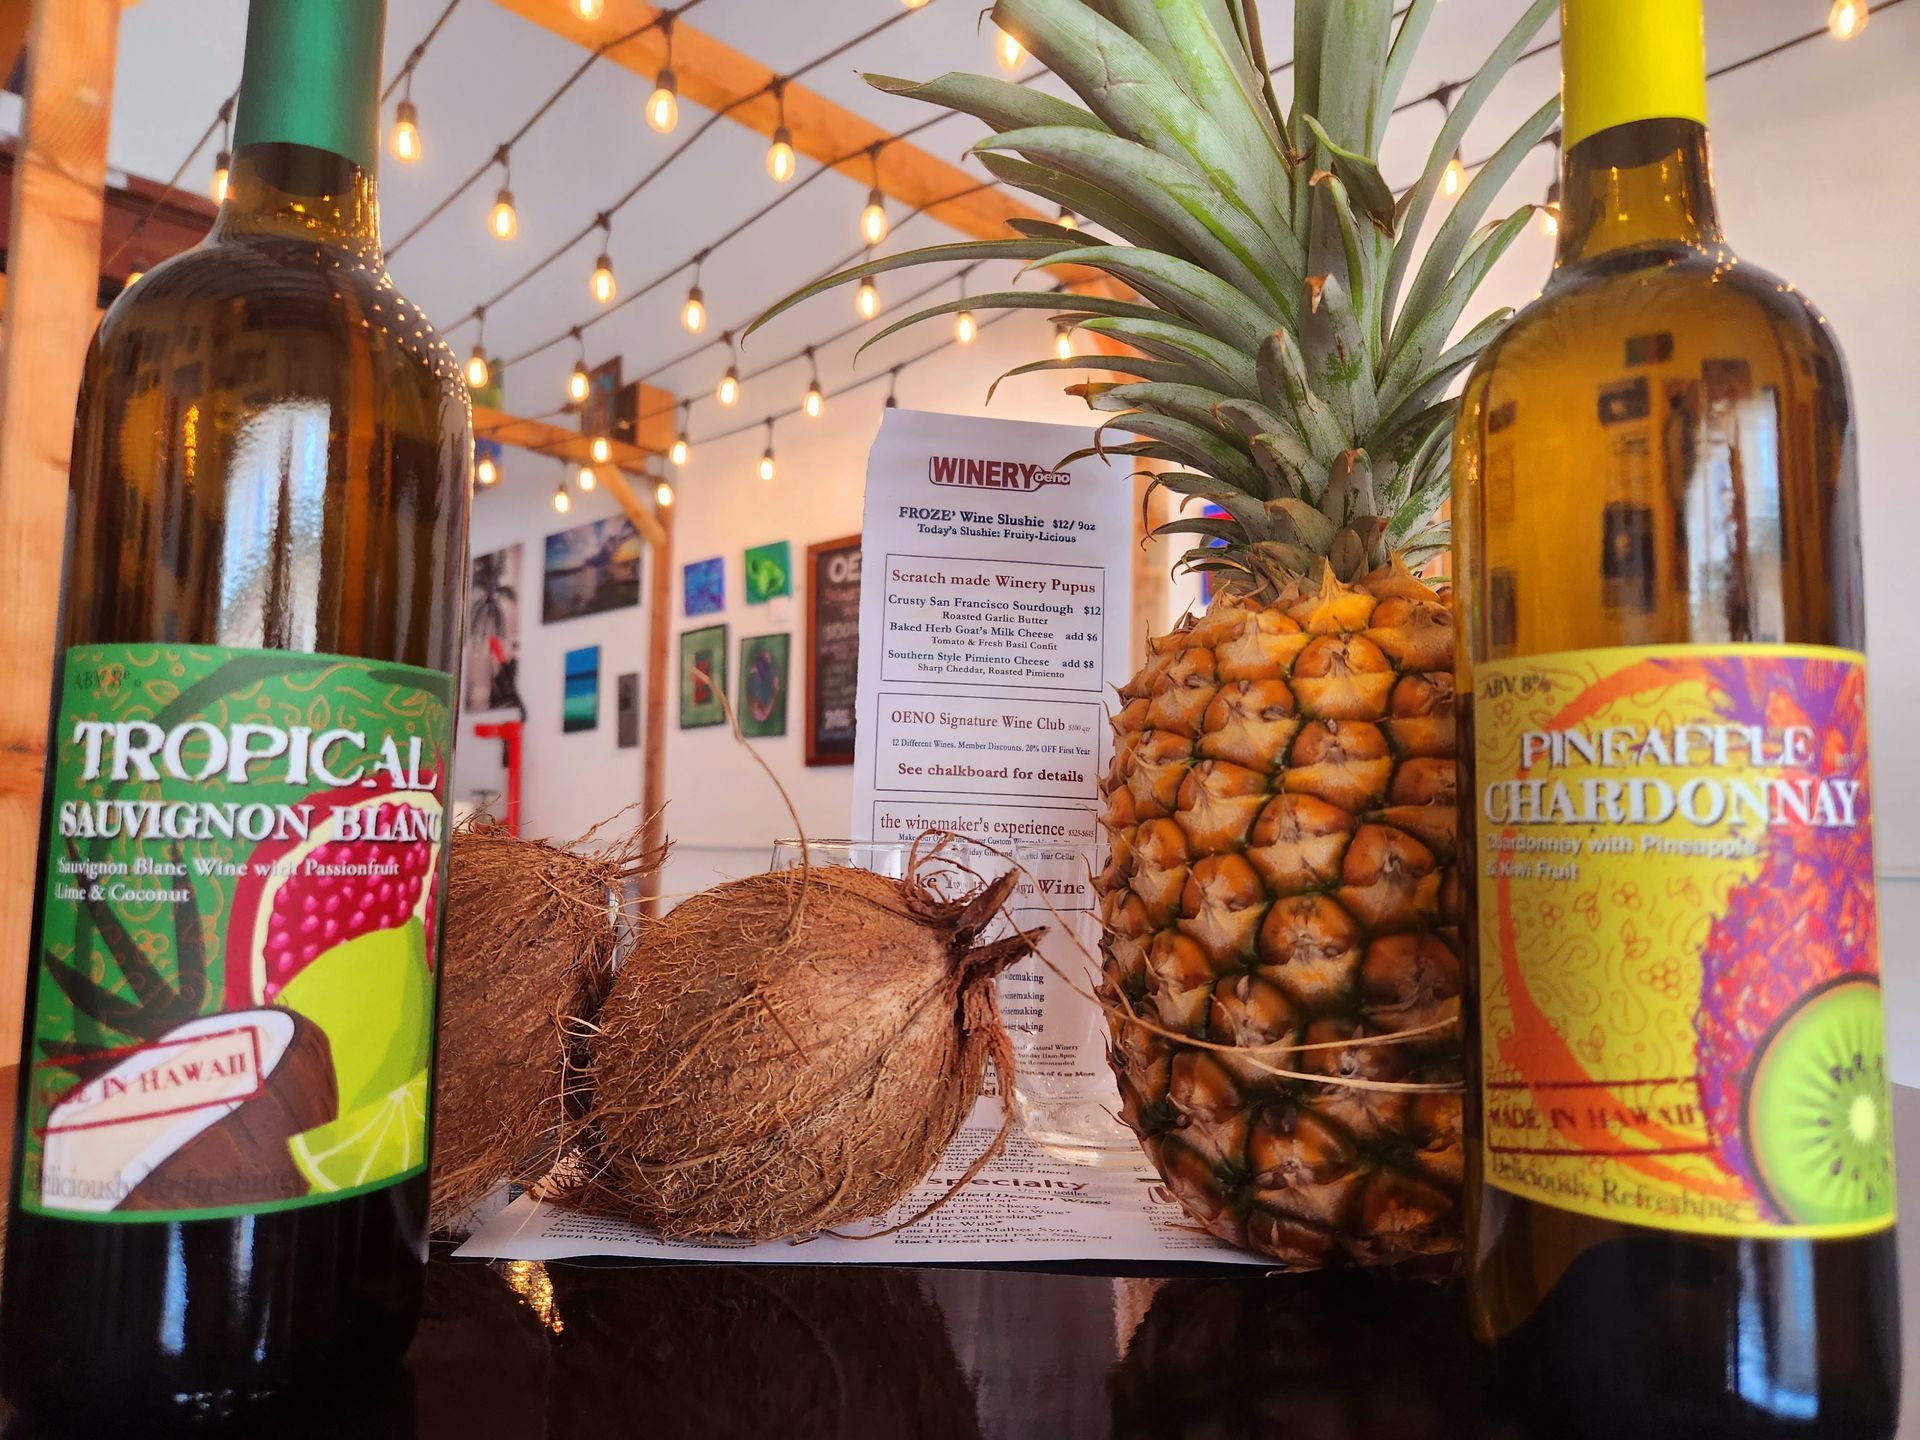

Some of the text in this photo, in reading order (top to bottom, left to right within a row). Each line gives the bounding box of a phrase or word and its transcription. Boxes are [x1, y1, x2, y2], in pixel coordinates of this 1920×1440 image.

[933, 456, 1037, 489] WINERY
[960, 511, 994, 524] Wine
[997, 514, 1045, 528] Slushie
[1052, 519, 1074, 531] $12/
[1078, 520, 1095, 531] 9oz
[960, 527, 1001, 538] Slushie:
[1003, 530, 1076, 543] Fruity-Licious
[892, 570, 1096, 595] Scratch made Winery Pupus
[888, 595, 1101, 616] Crusty San Francisco Sourdough $12
[942, 611, 1048, 625] Roasted Garlic Butter
[890, 622, 922, 633] Baked
[925, 623, 952, 634] Herb
[991, 627, 1014, 637] Milk
[1017, 628, 1054, 639] Cheese
[1065, 632, 1084, 641] add
[1087, 632, 1098, 642] $6
[931, 636, 1057, 651] Tomato & Fresh Basil Confit
[888, 650, 1095, 669] Southern Style Pimiento Cheese add $8
[918, 663, 1065, 679] Sharp Cheddar, Roasted Pimiento
[1480, 674, 1520, 700] ABV
[891, 711, 935, 724] OENO
[939, 713, 998, 729] Signature
[1002, 715, 1033, 729] Wine
[1037, 717, 1065, 731] Club
[73, 719, 439, 790] TROPICAL
[892, 739, 900, 747] 12
[901, 739, 932, 748] Different
[958, 741, 986, 751] Member
[1041, 745, 1057, 754] OFF
[1059, 746, 1074, 754] First
[1075, 747, 1090, 755] Year
[1521, 724, 1816, 770] PINEAPPLE
[898, 763, 1084, 782] See chalkboard for details
[1484, 777, 1860, 828] CHARDONNAY
[58, 800, 442, 844] SAUVIGNON BLANC
[881, 814, 900, 829] the
[994, 820, 1065, 838] experience
[1486, 833, 1759, 858] Chardonnay with Pineapple
[56, 856, 129, 877] Sauvignon
[133, 858, 187, 877] Blanc
[194, 859, 248, 877] Wine
[304, 858, 400, 878] Passionfruit
[1536, 861, 1579, 881] Fruit
[54, 883, 190, 902] Lime & Coconut
[1038, 879, 1085, 895] Wine
[102, 1077, 127, 1100] IN
[139, 1053, 248, 1093] HAWAII
[1551, 1108, 1575, 1129] IN
[1586, 1104, 1696, 1130] HAWAII
[540, 1232, 583, 1240] Green
[587, 1234, 631, 1243] Apple
